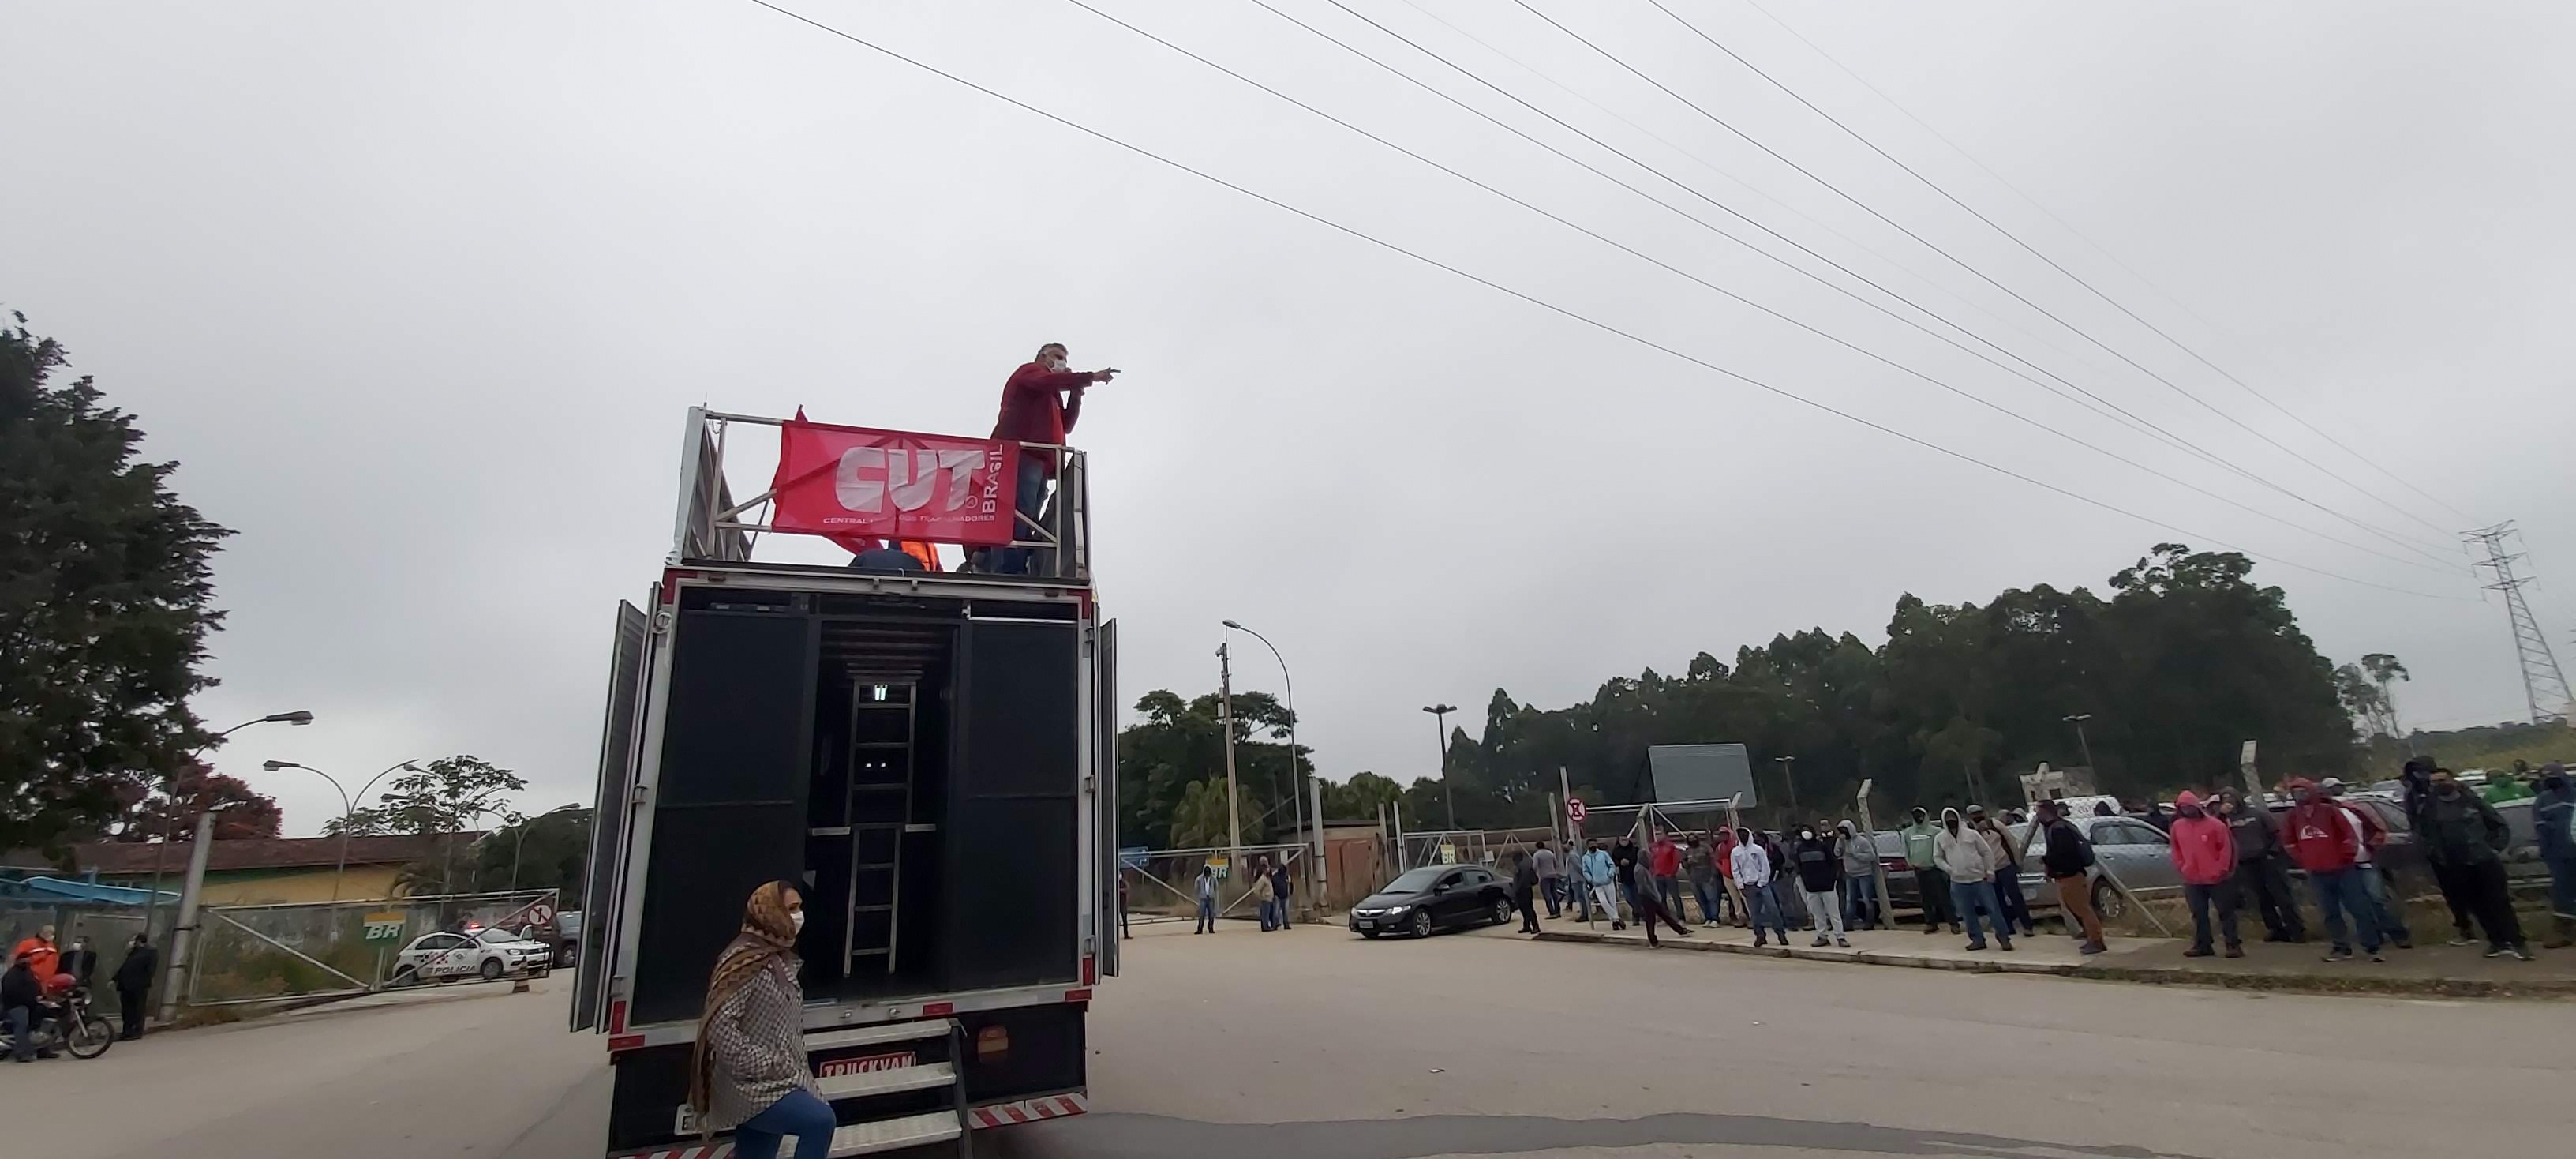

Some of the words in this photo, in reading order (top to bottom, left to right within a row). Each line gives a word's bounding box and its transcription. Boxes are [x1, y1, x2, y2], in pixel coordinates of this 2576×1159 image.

[836, 446, 986, 513] CUT
[983, 444, 1004, 514] BRASIL
[1443, 852, 1455, 865] BR
[365, 923, 401, 940] BR
[825, 1055, 912, 1077] TRUCKVAN
